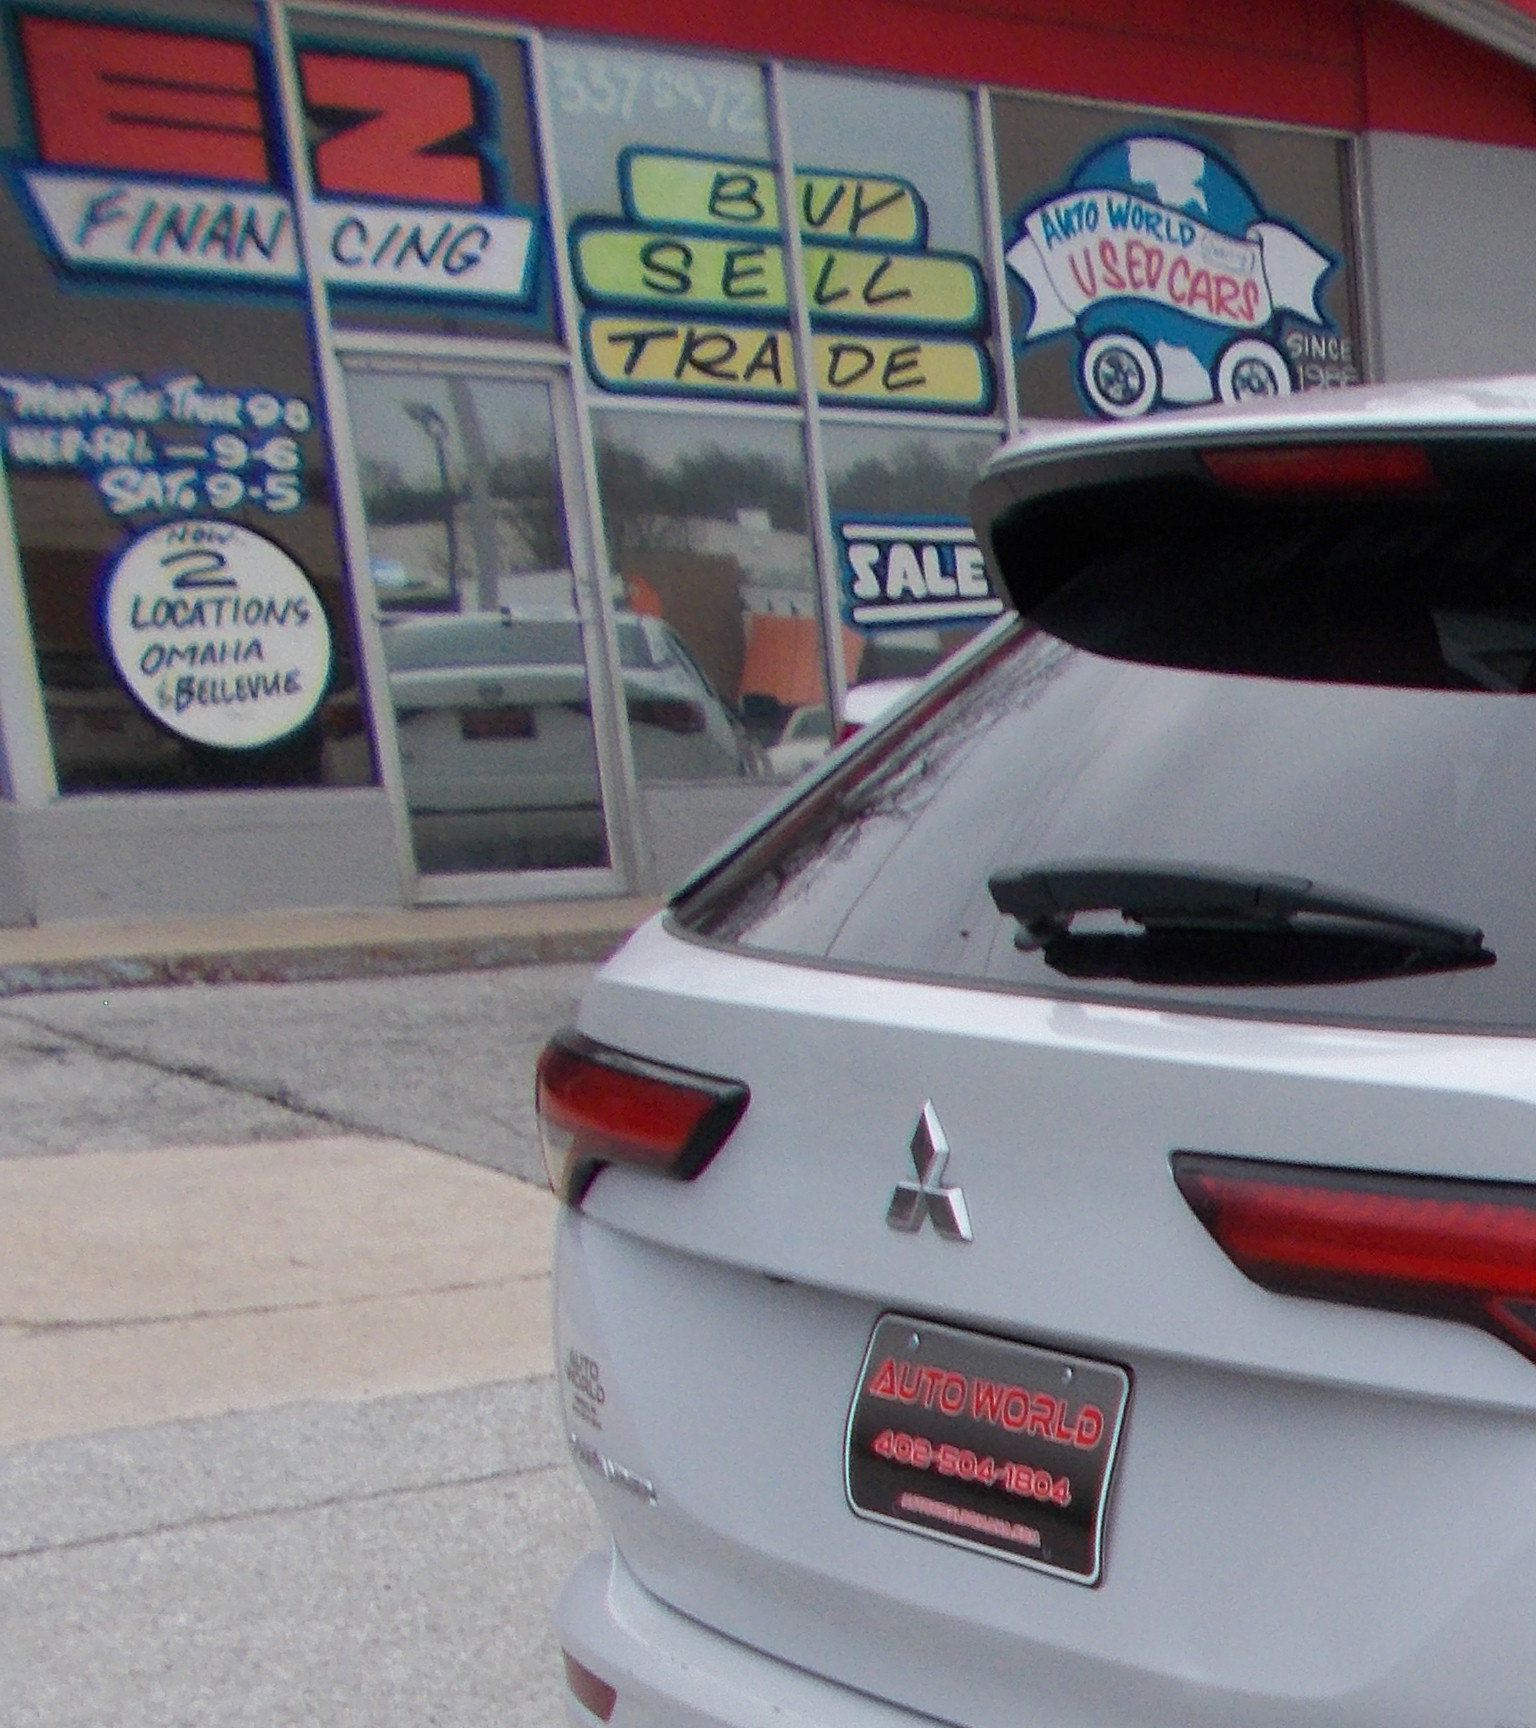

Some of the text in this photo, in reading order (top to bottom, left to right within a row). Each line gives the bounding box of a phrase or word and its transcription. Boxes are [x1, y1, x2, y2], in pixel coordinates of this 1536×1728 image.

[20, 15, 486, 207] EZ
[76, 187, 490, 276] FINANCING
[708, 171, 907, 237] BUY
[1040, 197, 1100, 248] AUTO
[1107, 196, 1197, 250] WORLD
[640, 236, 914, 307] SELL
[1068, 236, 1165, 298] USED
[1167, 254, 1260, 322] CARS
[607, 327, 928, 392] TRADE
[1286, 331, 1352, 365] SINCE
[160, 549, 238, 589] 2
[847, 541, 990, 600] SALE
[131, 594, 311, 629] LOCATIONS
[138, 638, 264, 676] OMAHA
[174, 668, 303, 714] BELLEVUE
[869, 1355, 1105, 1450] AUTO WORLD
